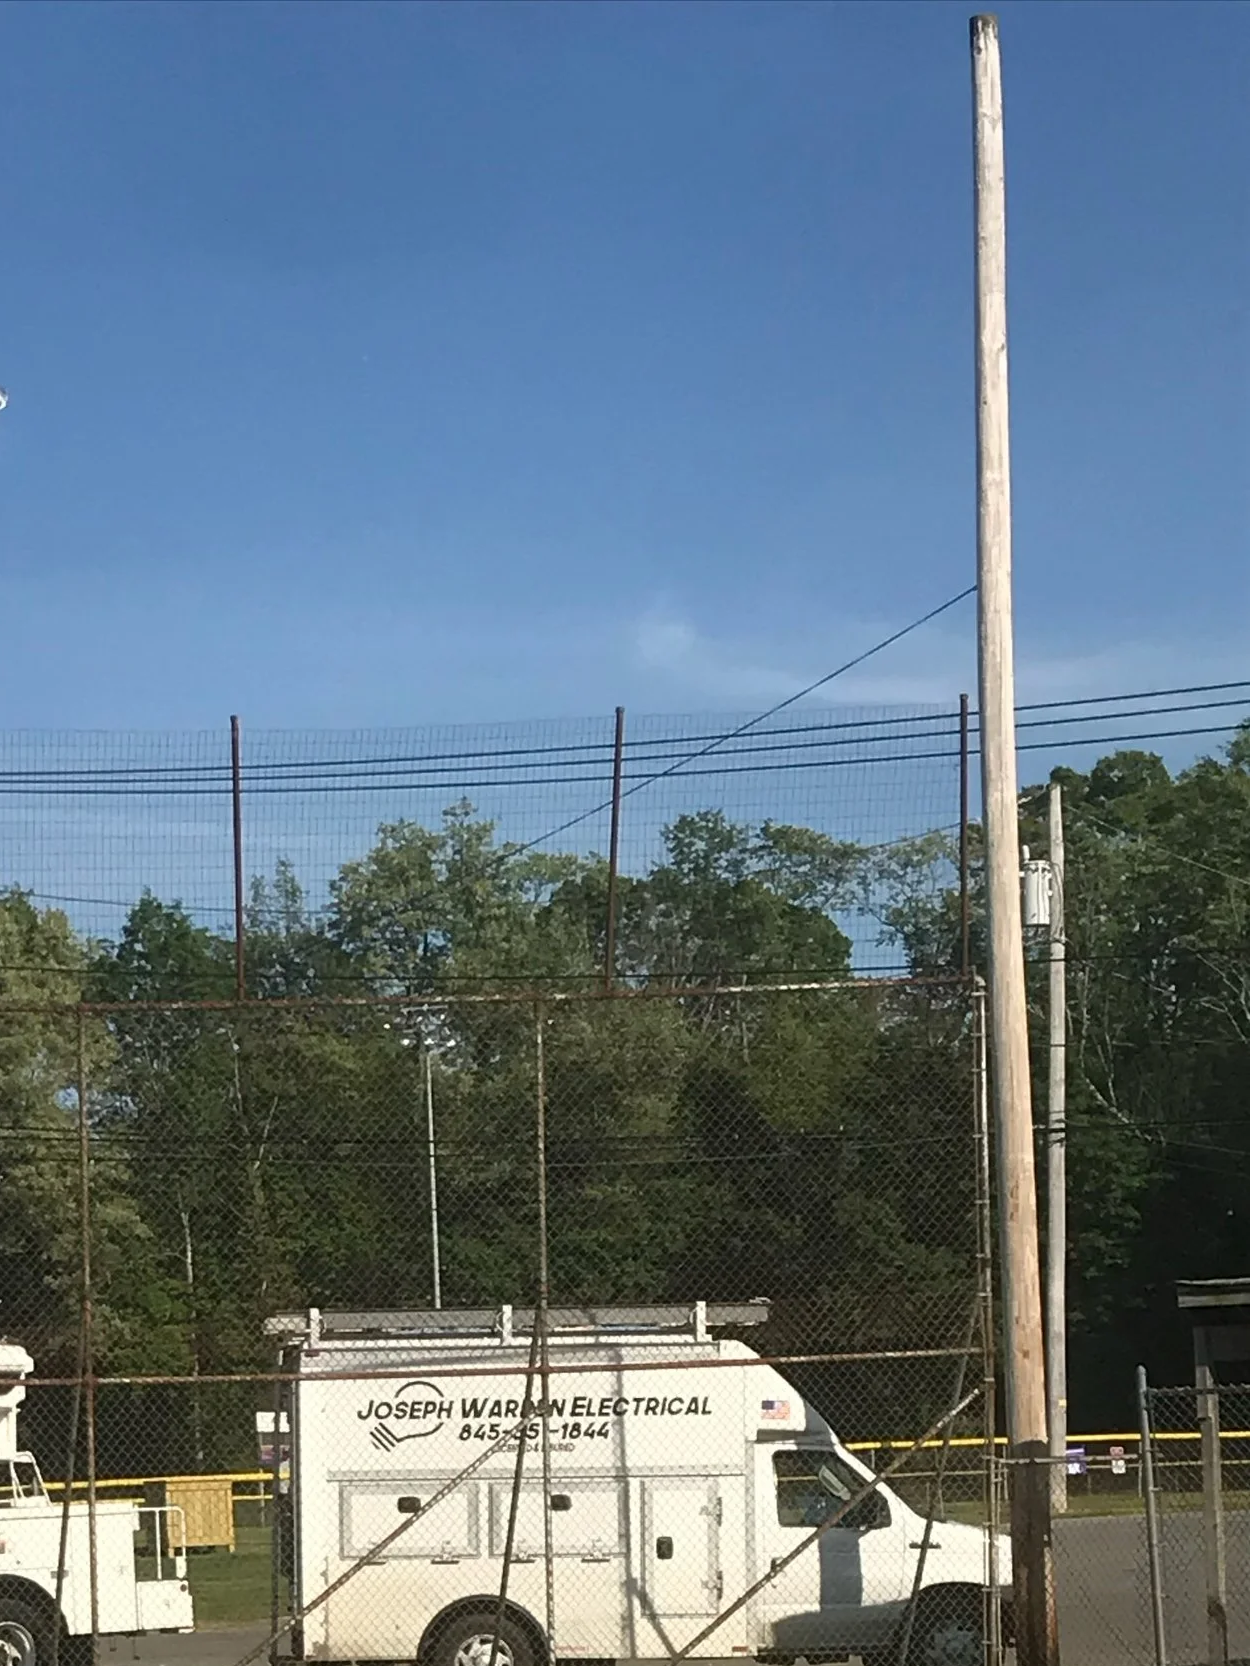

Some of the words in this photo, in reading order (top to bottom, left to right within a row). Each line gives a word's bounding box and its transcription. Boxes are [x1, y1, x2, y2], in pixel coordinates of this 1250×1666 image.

[357, 1400, 454, 1420] JOSEPH
[461, 1398, 566, 1419] WARDN
[569, 1396, 712, 1417] ELECTRICAL
[459, 1422, 610, 1441] 845-5-1844
